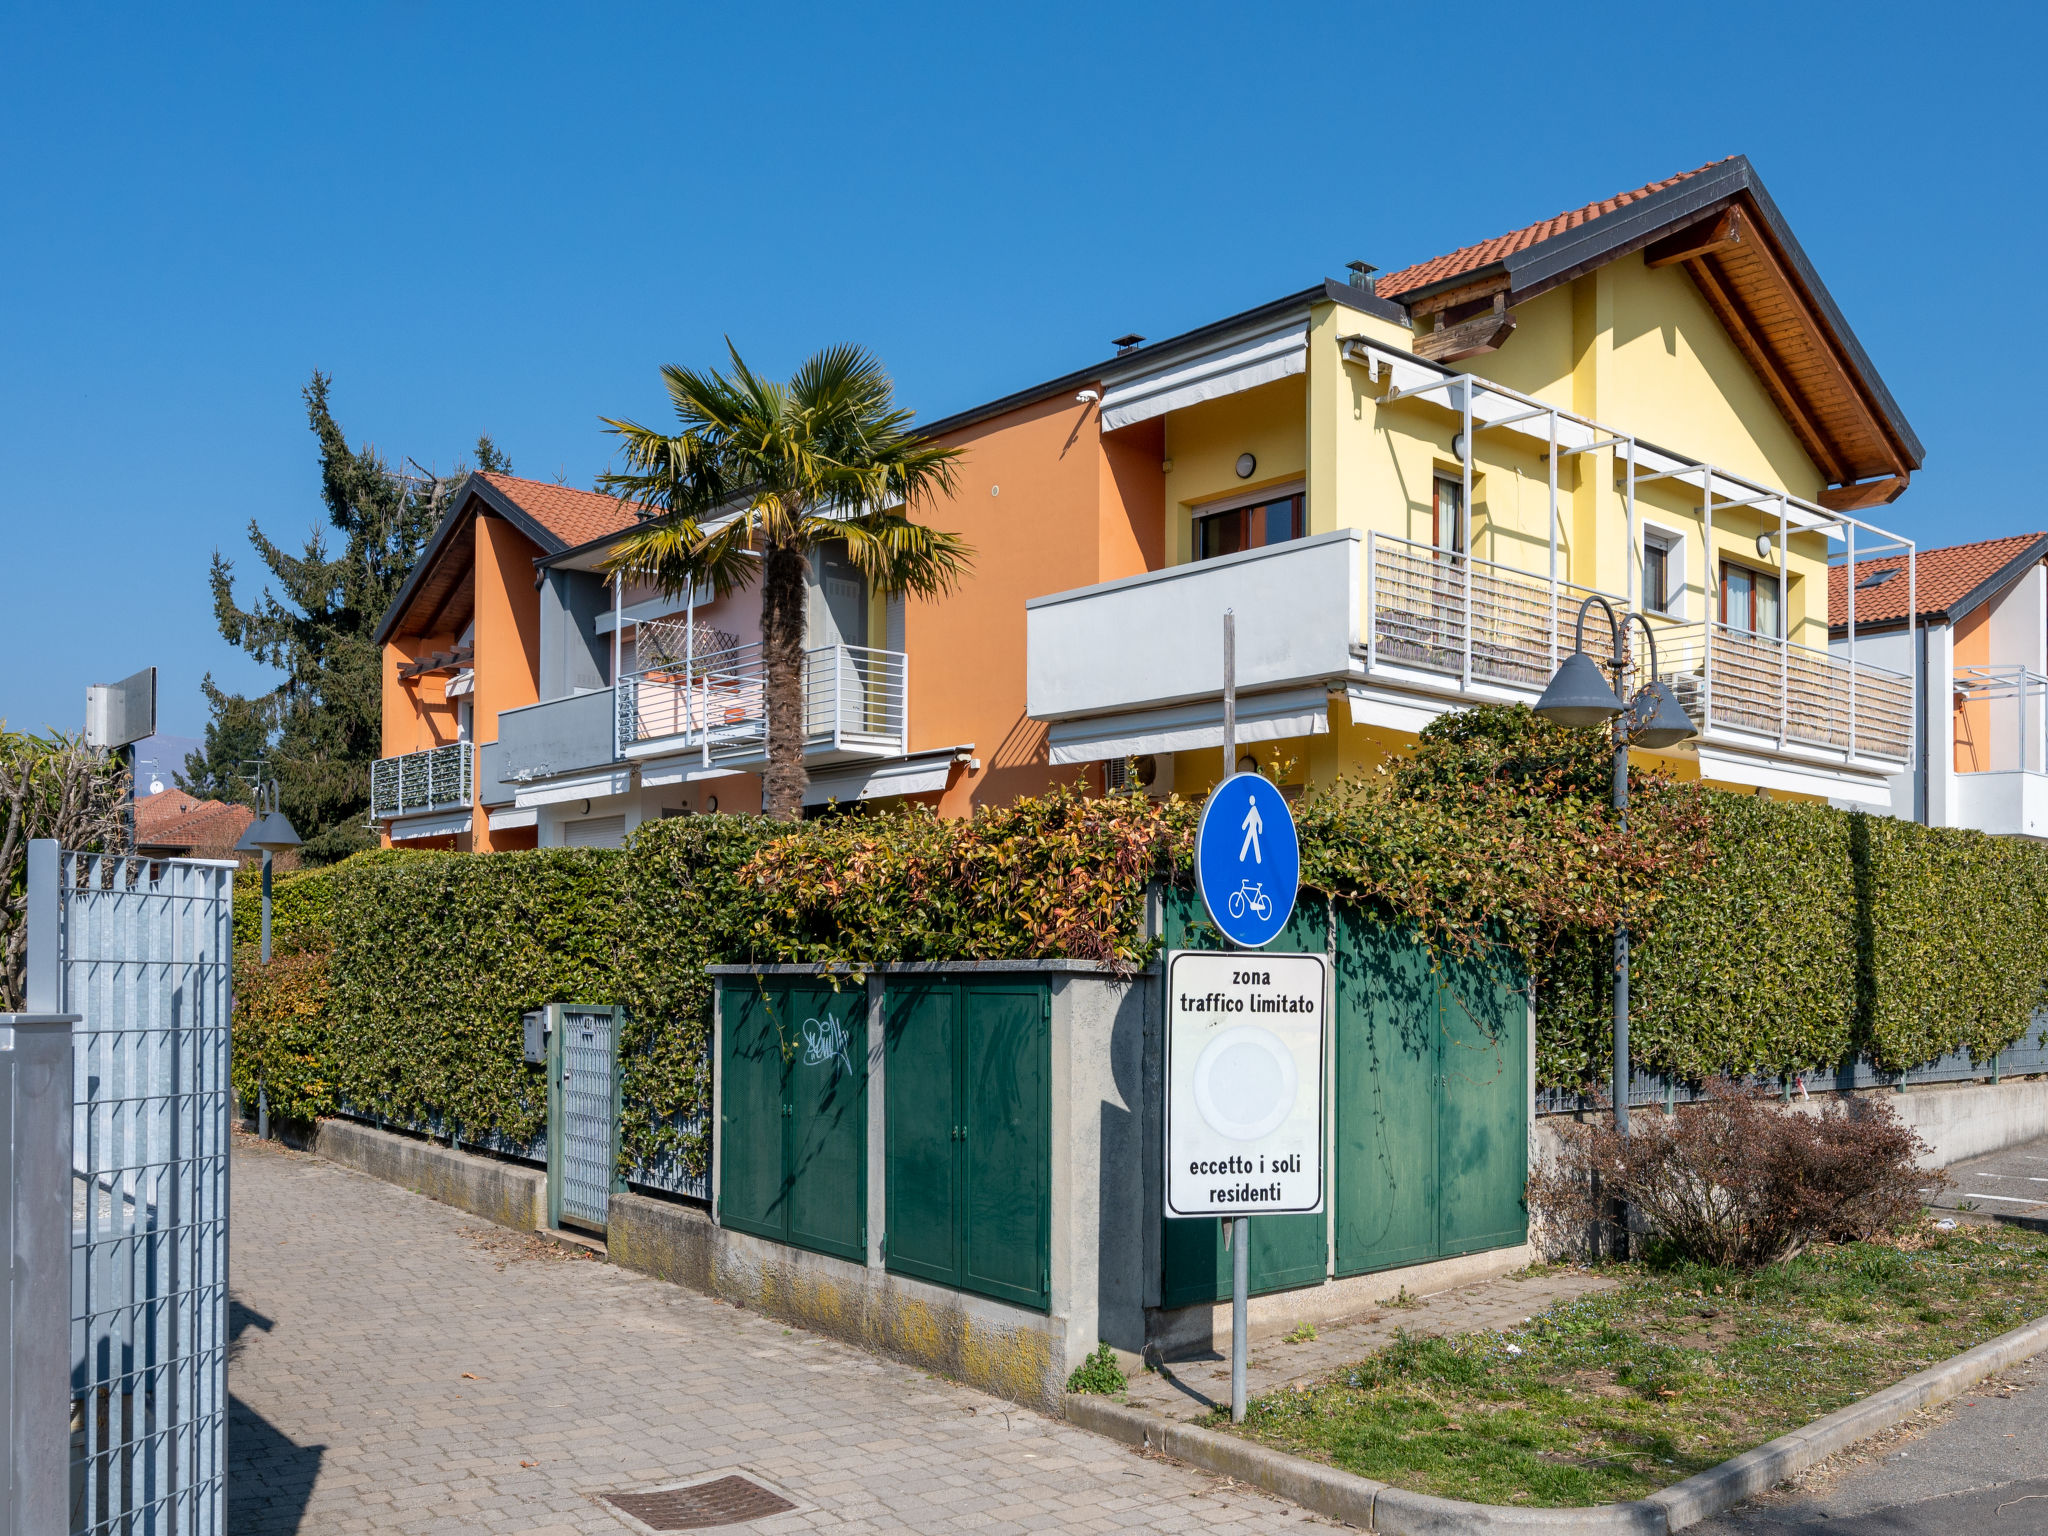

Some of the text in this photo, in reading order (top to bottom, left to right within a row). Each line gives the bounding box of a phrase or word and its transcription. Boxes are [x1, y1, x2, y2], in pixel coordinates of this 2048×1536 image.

[1232, 971, 1271, 986] zona
[1180, 992, 1314, 1014] traffico limitato
[1189, 1153, 1301, 1175] eccetto i soli
[1209, 1182, 1281, 1203] residenti
